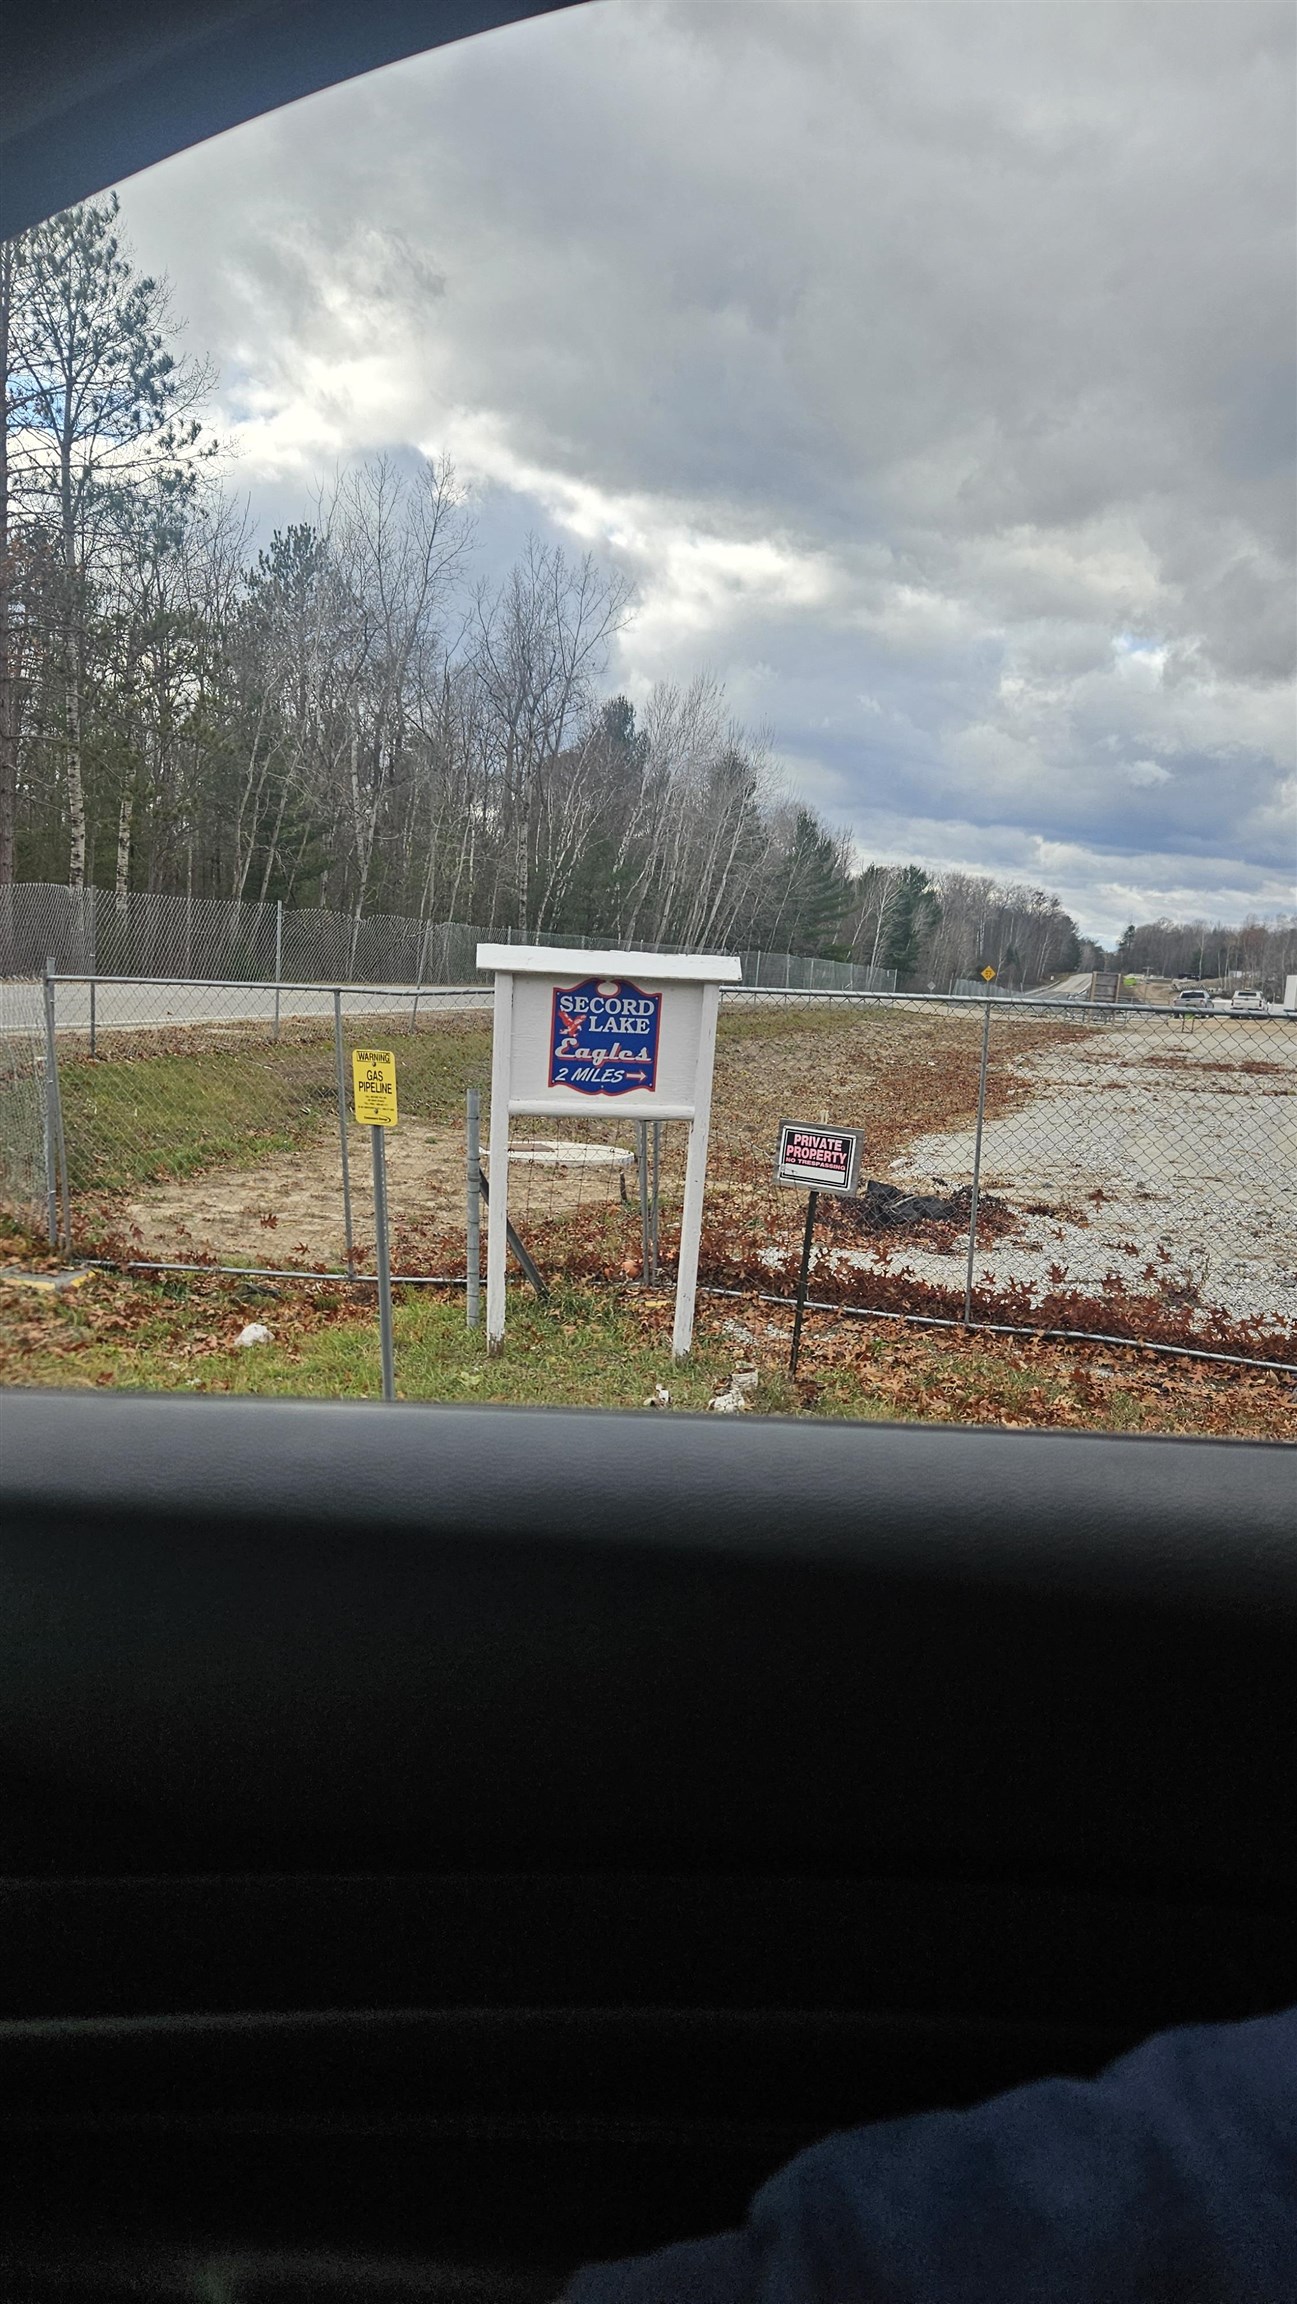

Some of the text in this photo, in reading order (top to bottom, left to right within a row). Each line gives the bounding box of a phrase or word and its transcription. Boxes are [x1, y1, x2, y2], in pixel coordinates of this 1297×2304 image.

[560, 996, 655, 1016] SECORD
[588, 1015, 650, 1034] LAKE
[358, 1052, 390, 1063] WARNING
[554, 1037, 653, 1067] Eagles
[366, 1070, 383, 1081] GAS
[555, 1067, 625, 1083] 2 MILES
[358, 1081, 392, 1094] PIPELINE
[794, 1134, 842, 1151] PRIVATE
[786, 1144, 847, 1165] PROPERTY
[798, 1159, 846, 1171] TRESPASSING
